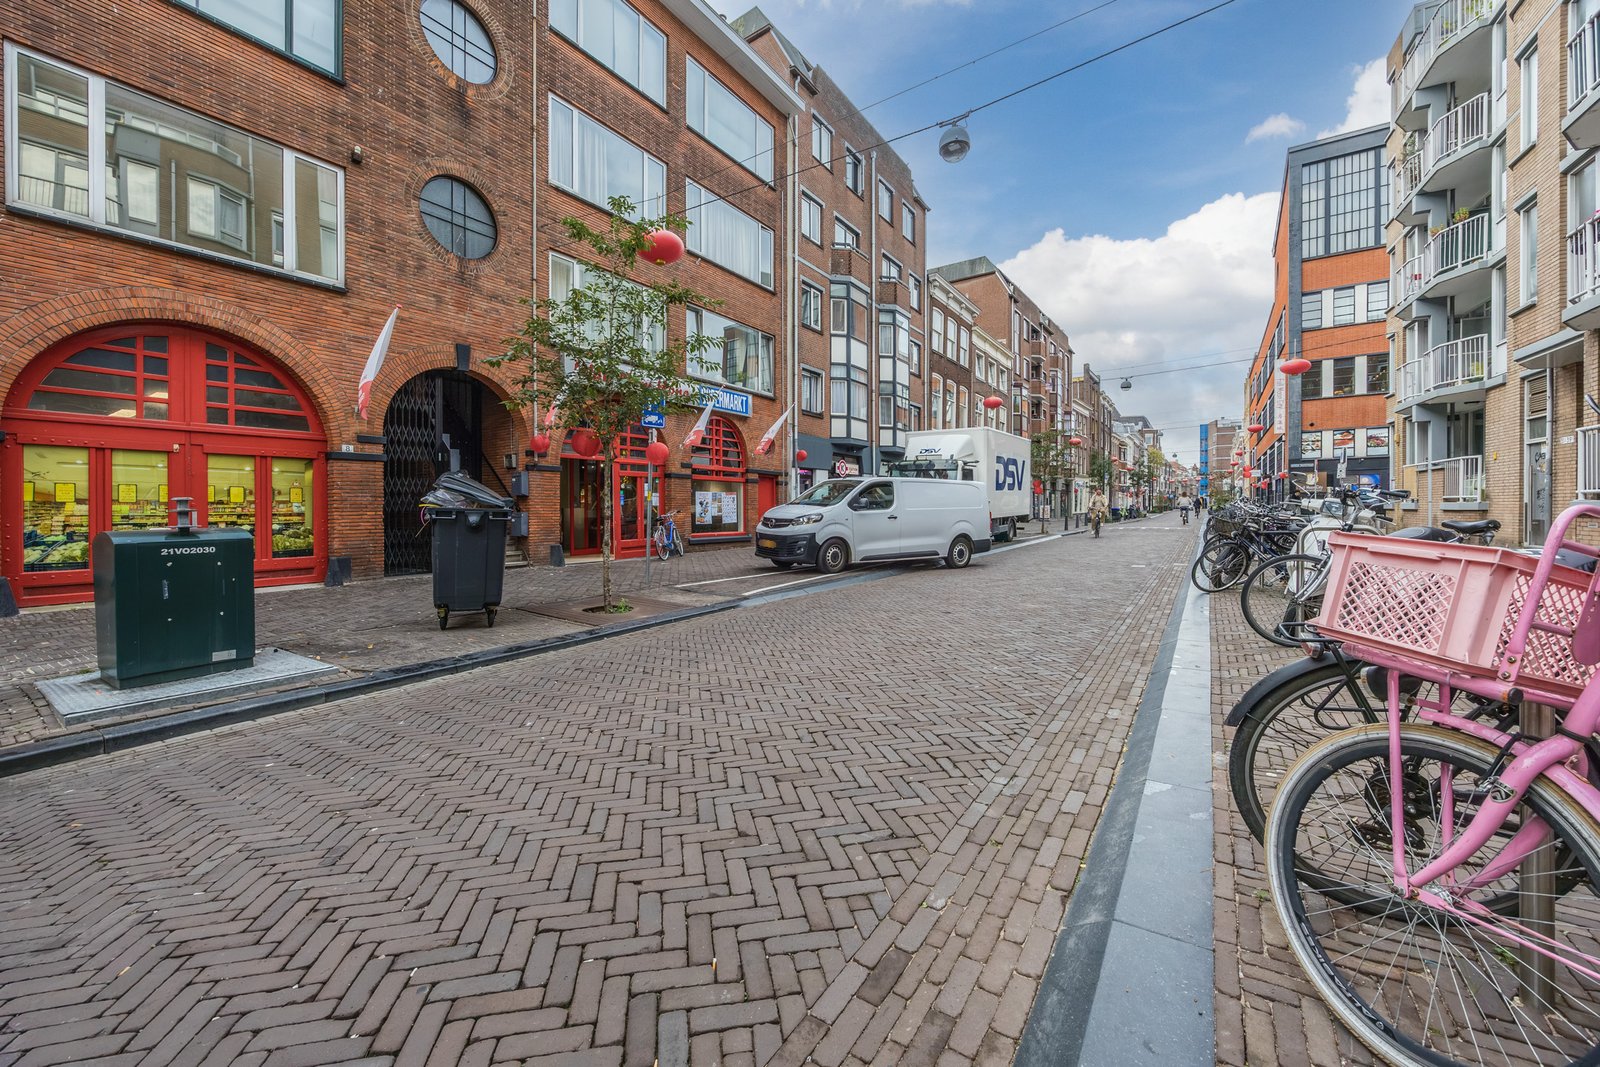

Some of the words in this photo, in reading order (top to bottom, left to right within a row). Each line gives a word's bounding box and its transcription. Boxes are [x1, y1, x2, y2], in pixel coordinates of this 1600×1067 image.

[701, 386, 747, 413] ERMARKT
[995, 455, 1026, 492] DSV
[160, 546, 216, 555] 21VO2030
